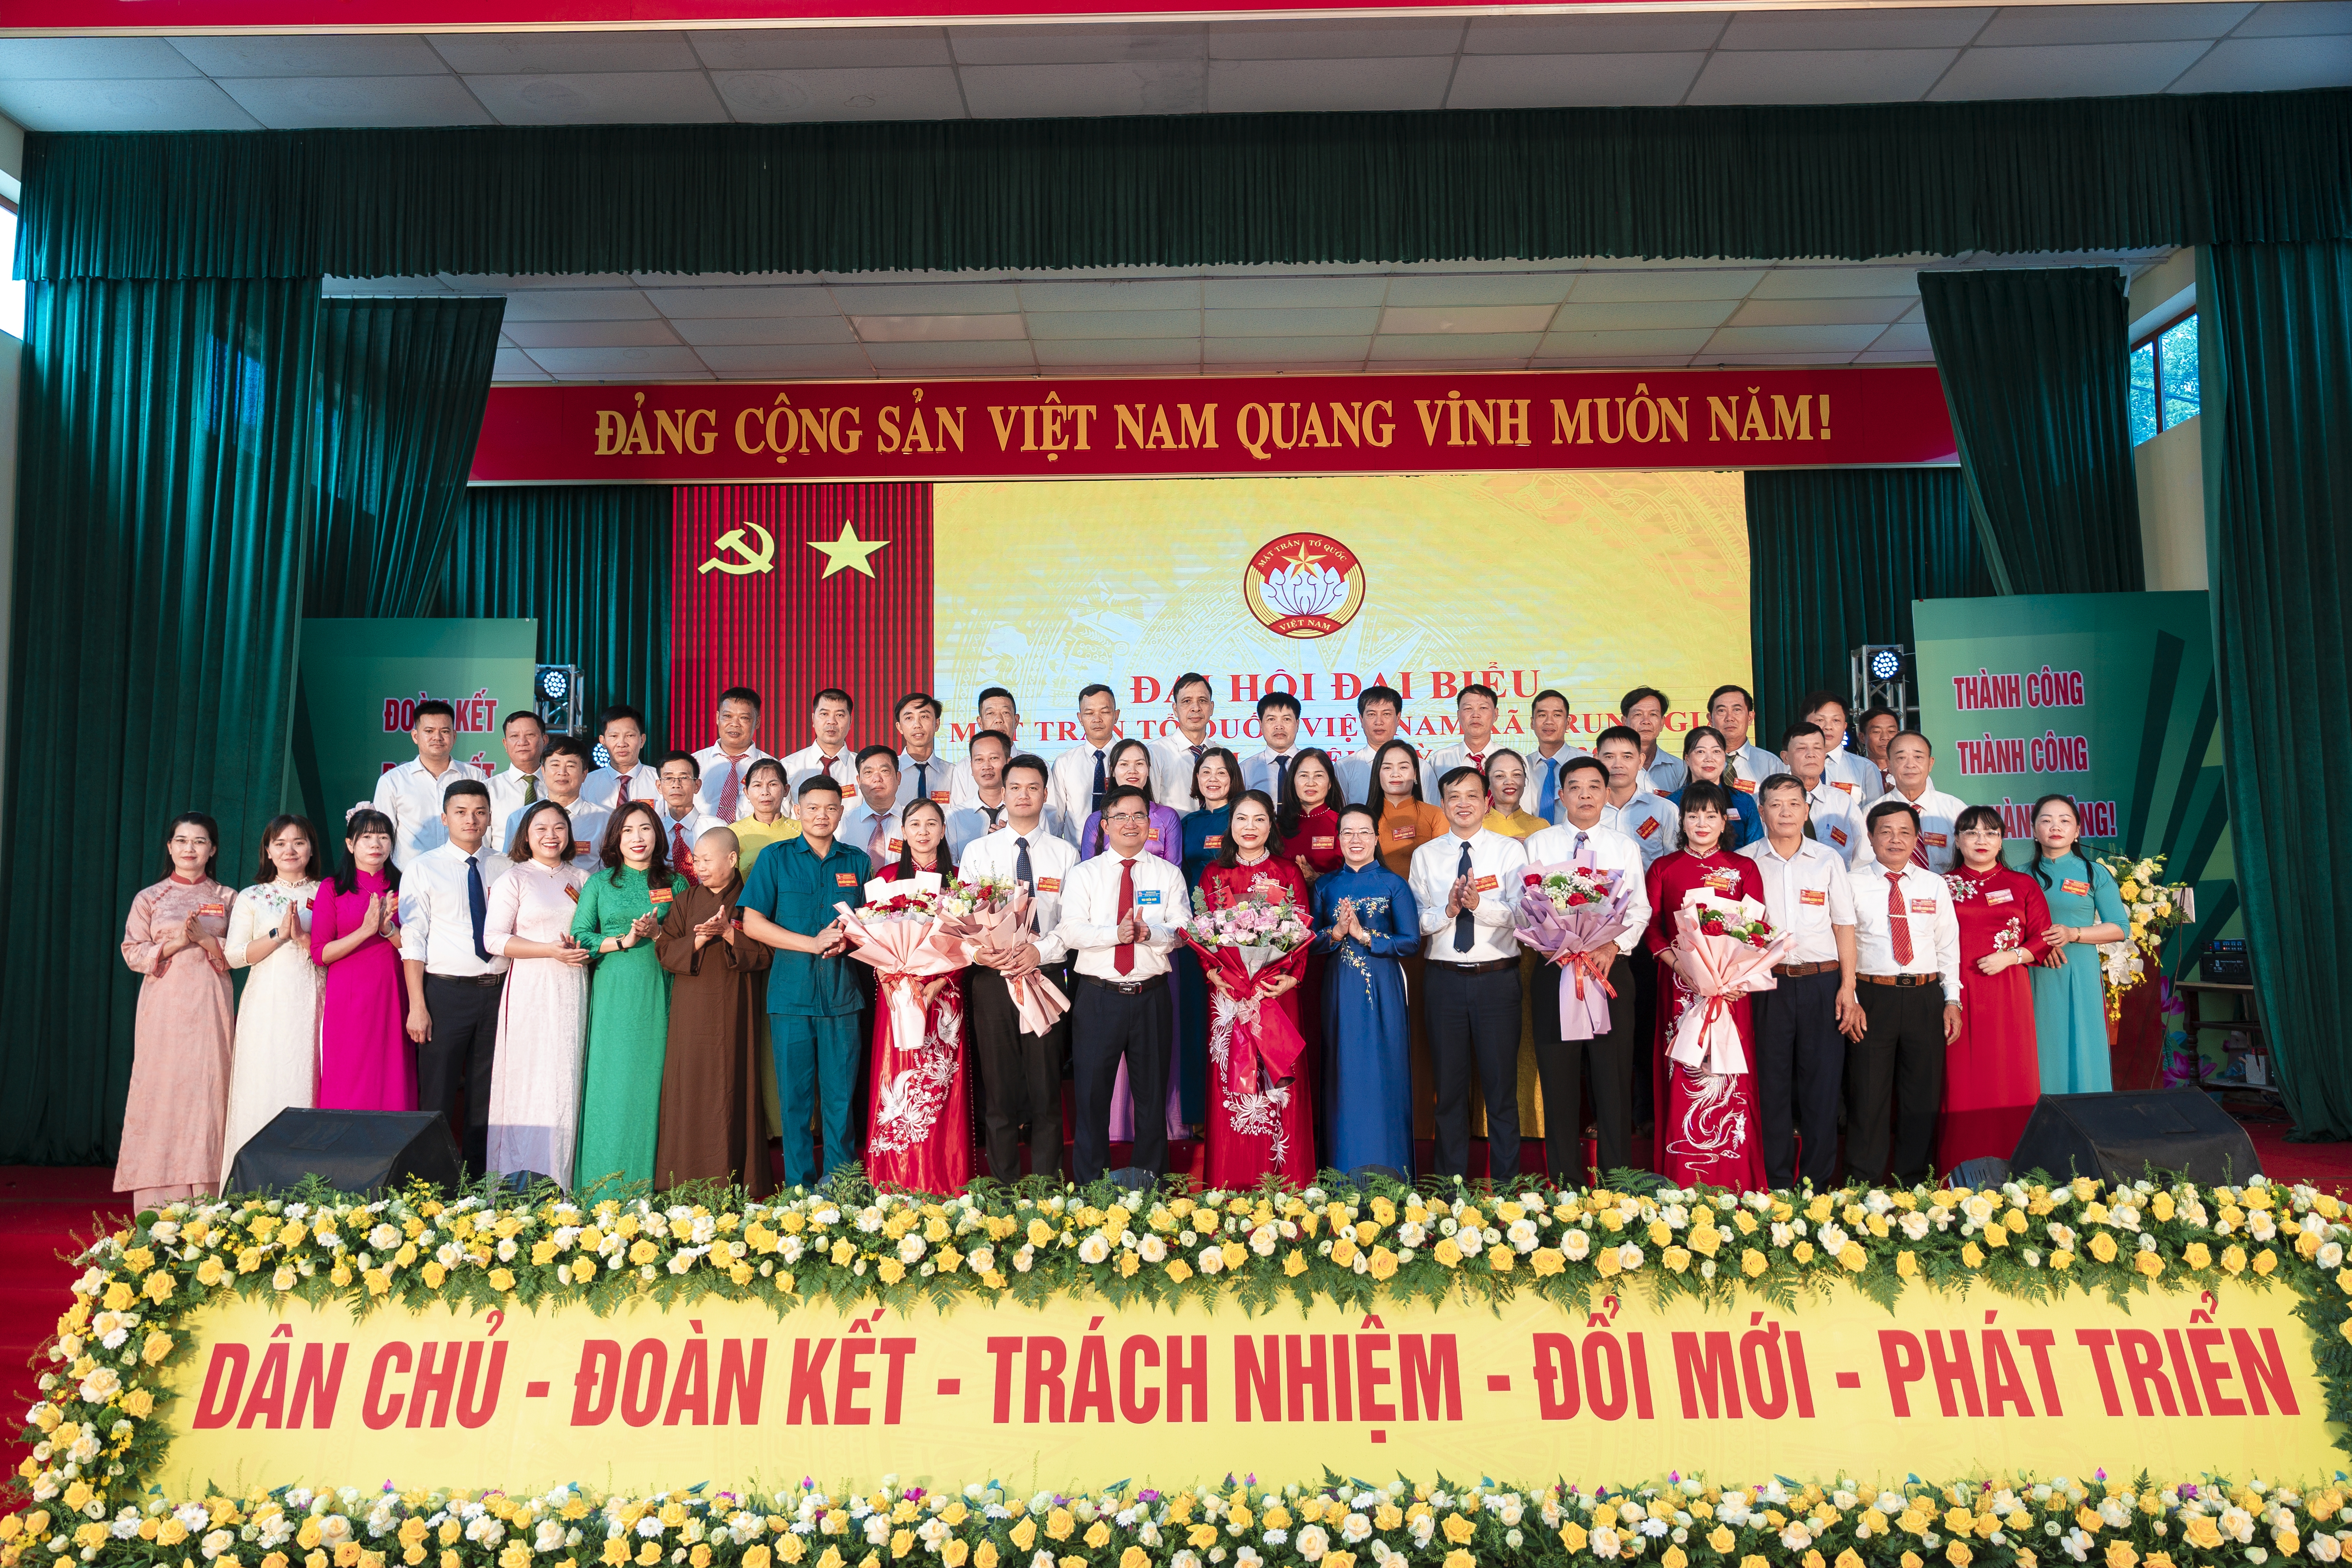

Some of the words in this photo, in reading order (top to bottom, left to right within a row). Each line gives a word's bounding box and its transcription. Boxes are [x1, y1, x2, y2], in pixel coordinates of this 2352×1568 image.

[595, 392, 718, 455] ĐẢNG
[735, 392, 862, 464] CỘNG
[878, 388, 967, 455] SẢN
[987, 391, 1096, 462] VIỆT
[1114, 403, 1219, 450] NAM
[1237, 400, 1396, 460] QUANG
[1550, 383, 1689, 444] MUÔN
[1706, 386, 1831, 441] NĂM!
[1258, 551, 1274, 568] MẶT
[1274, 540, 1300, 553] TRẬN
[1308, 539, 1322, 548] TỔ
[1323, 544, 1347, 562] QUỐC
[1279, 619, 1304, 631] VIỆT
[1307, 619, 1331, 631] NAM
[1954, 669, 2021, 710] THÀNH
[2027, 666, 2083, 707] CÔNG
[456, 689, 497, 732] KẾT
[1957, 733, 2025, 774] THÀNH
[2031, 731, 2087, 772] CÔNG
[1588, 962, 1598, 973] CHANEL
[192, 1324, 349, 1429] DÂN
[362, 1309, 509, 1430] CHỦ
[570, 1318, 768, 1428] ĐOÀN
[786, 1308, 916, 1425] KẾT
[987, 1316, 1208, 1424] TRÁCH
[1234, 1314, 1463, 1443] NHIỆM
[1533, 1295, 1654, 1421] ĐỔI
[1671, 1312, 1815, 1419] MỚI
[1878, 1310, 2063, 1417] PHÁT
[2075, 1290, 2301, 1416] TRIỂN
